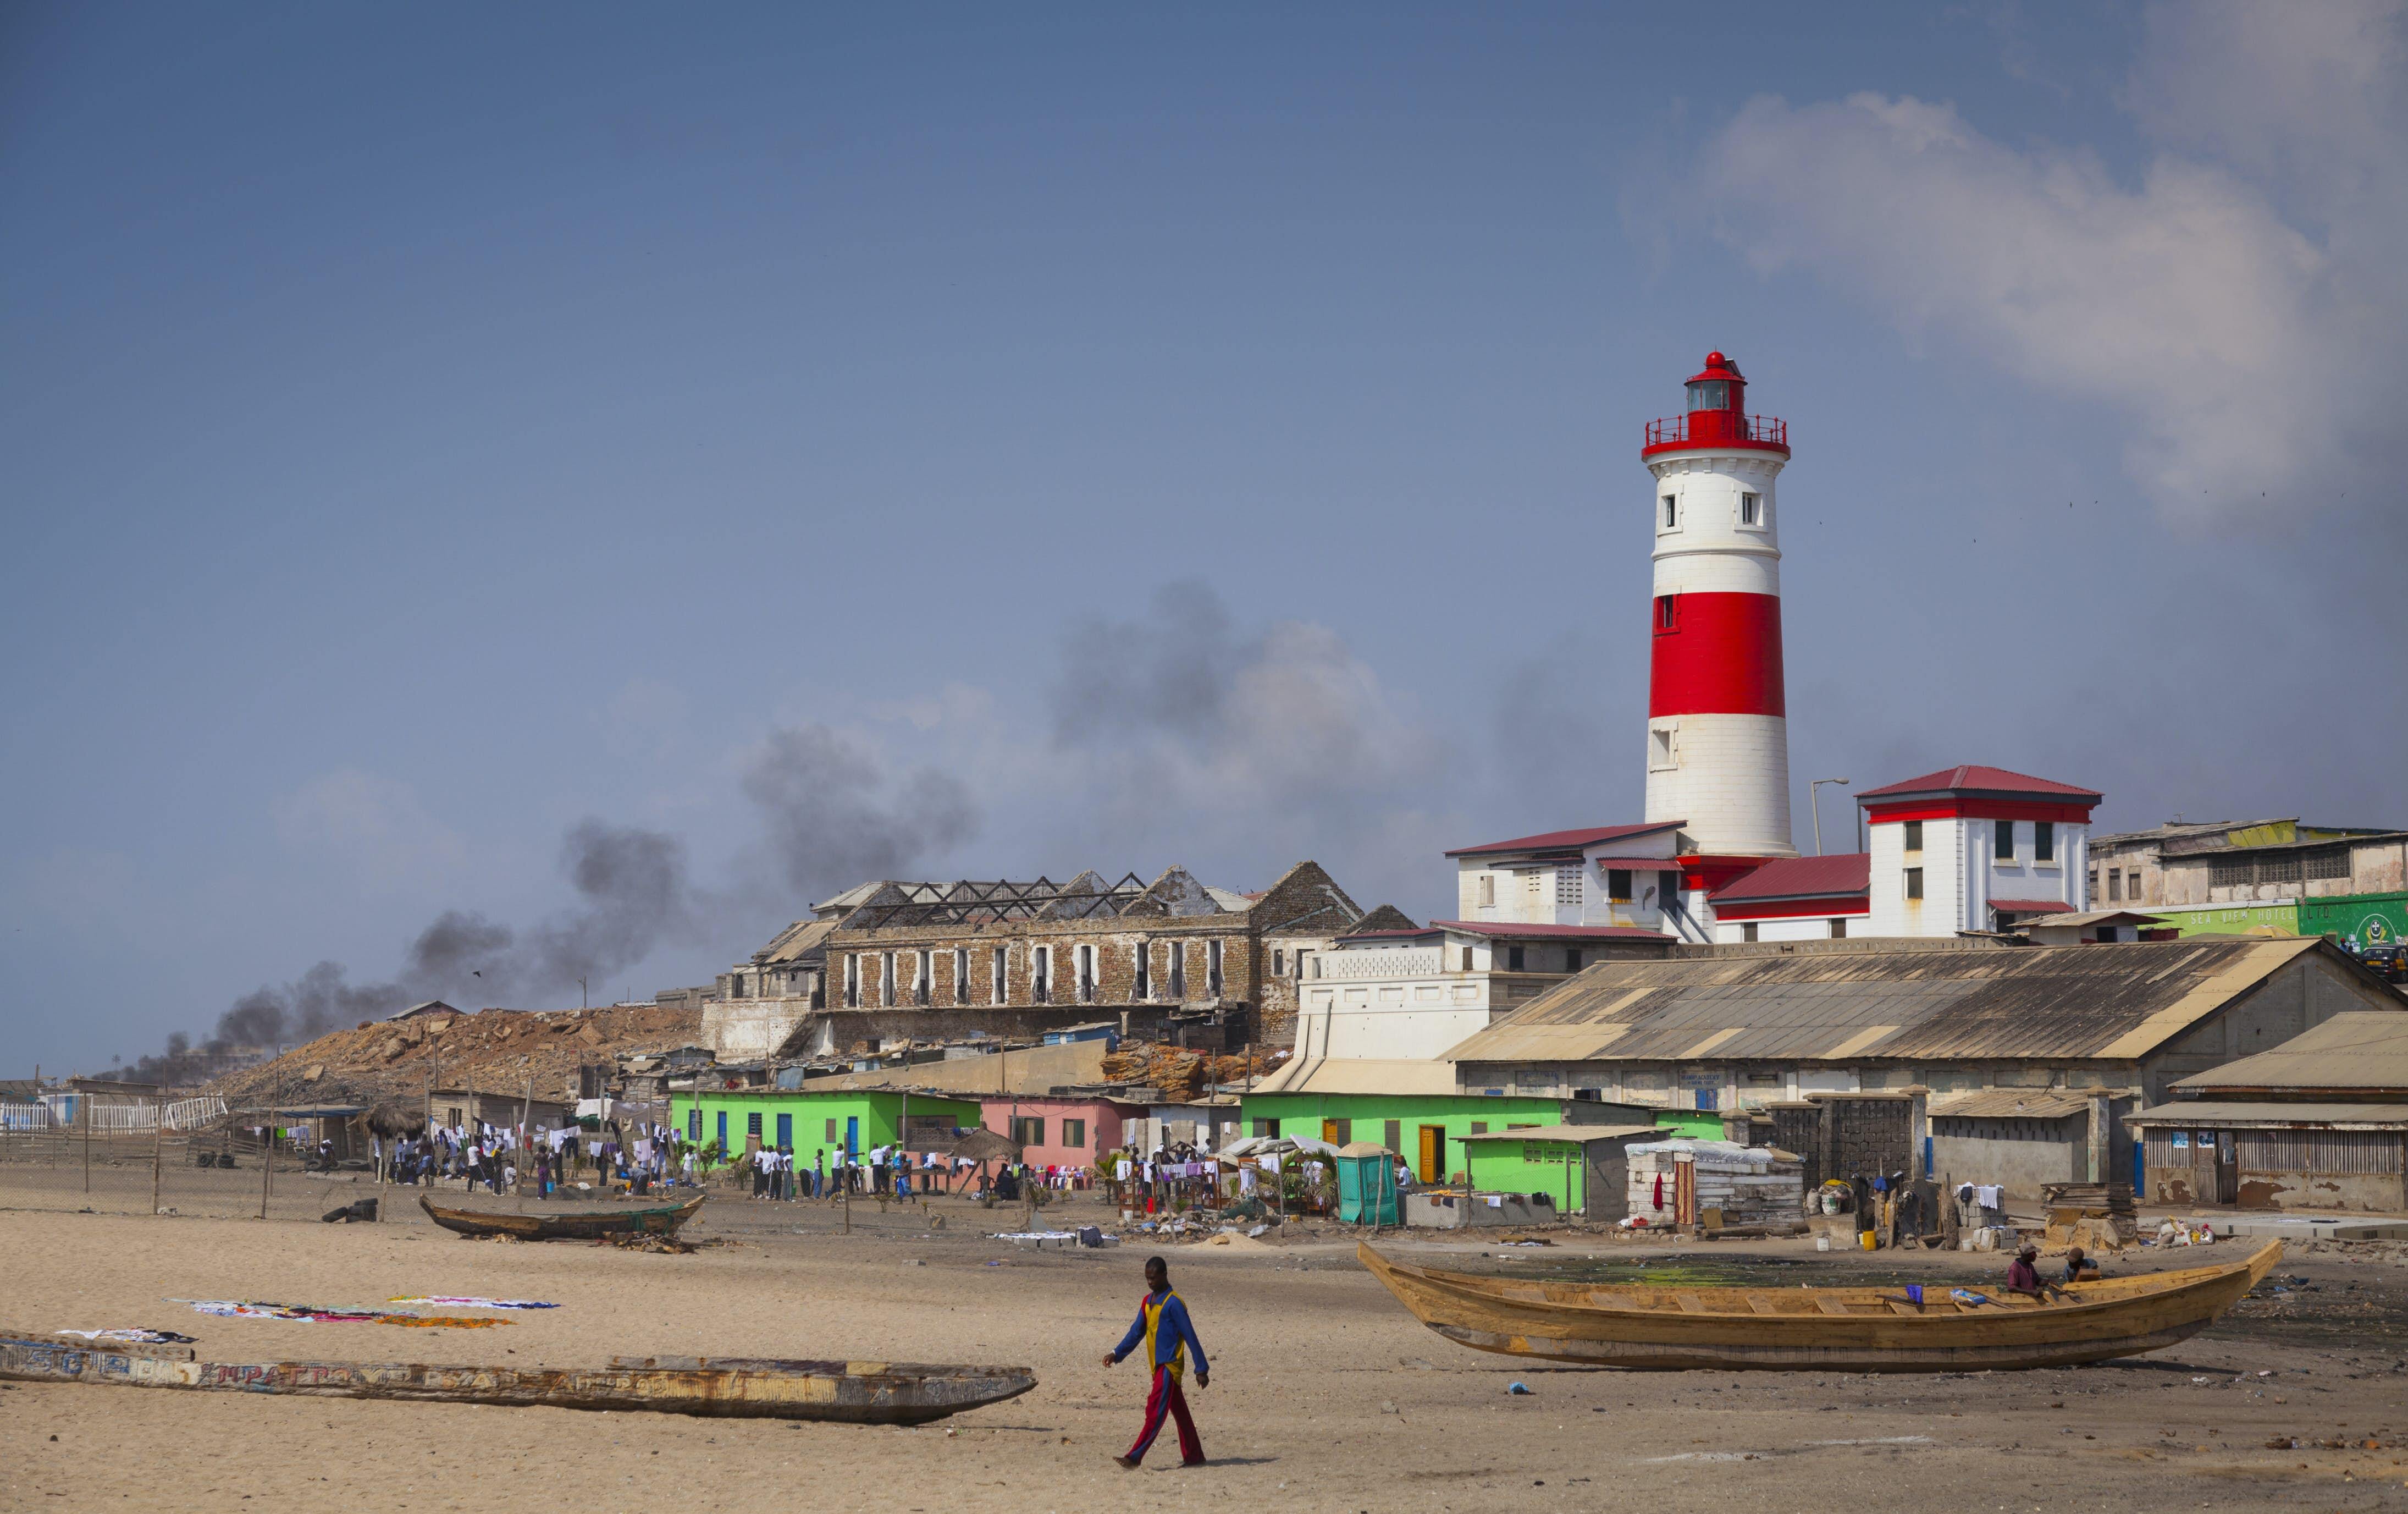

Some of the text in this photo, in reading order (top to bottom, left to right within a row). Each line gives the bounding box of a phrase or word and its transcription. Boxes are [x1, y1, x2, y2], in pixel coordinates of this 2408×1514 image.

[2191, 913, 2211, 925] SEA
[2222, 910, 2247, 923] VIEW
[2258, 908, 2294, 921] HOTEL
